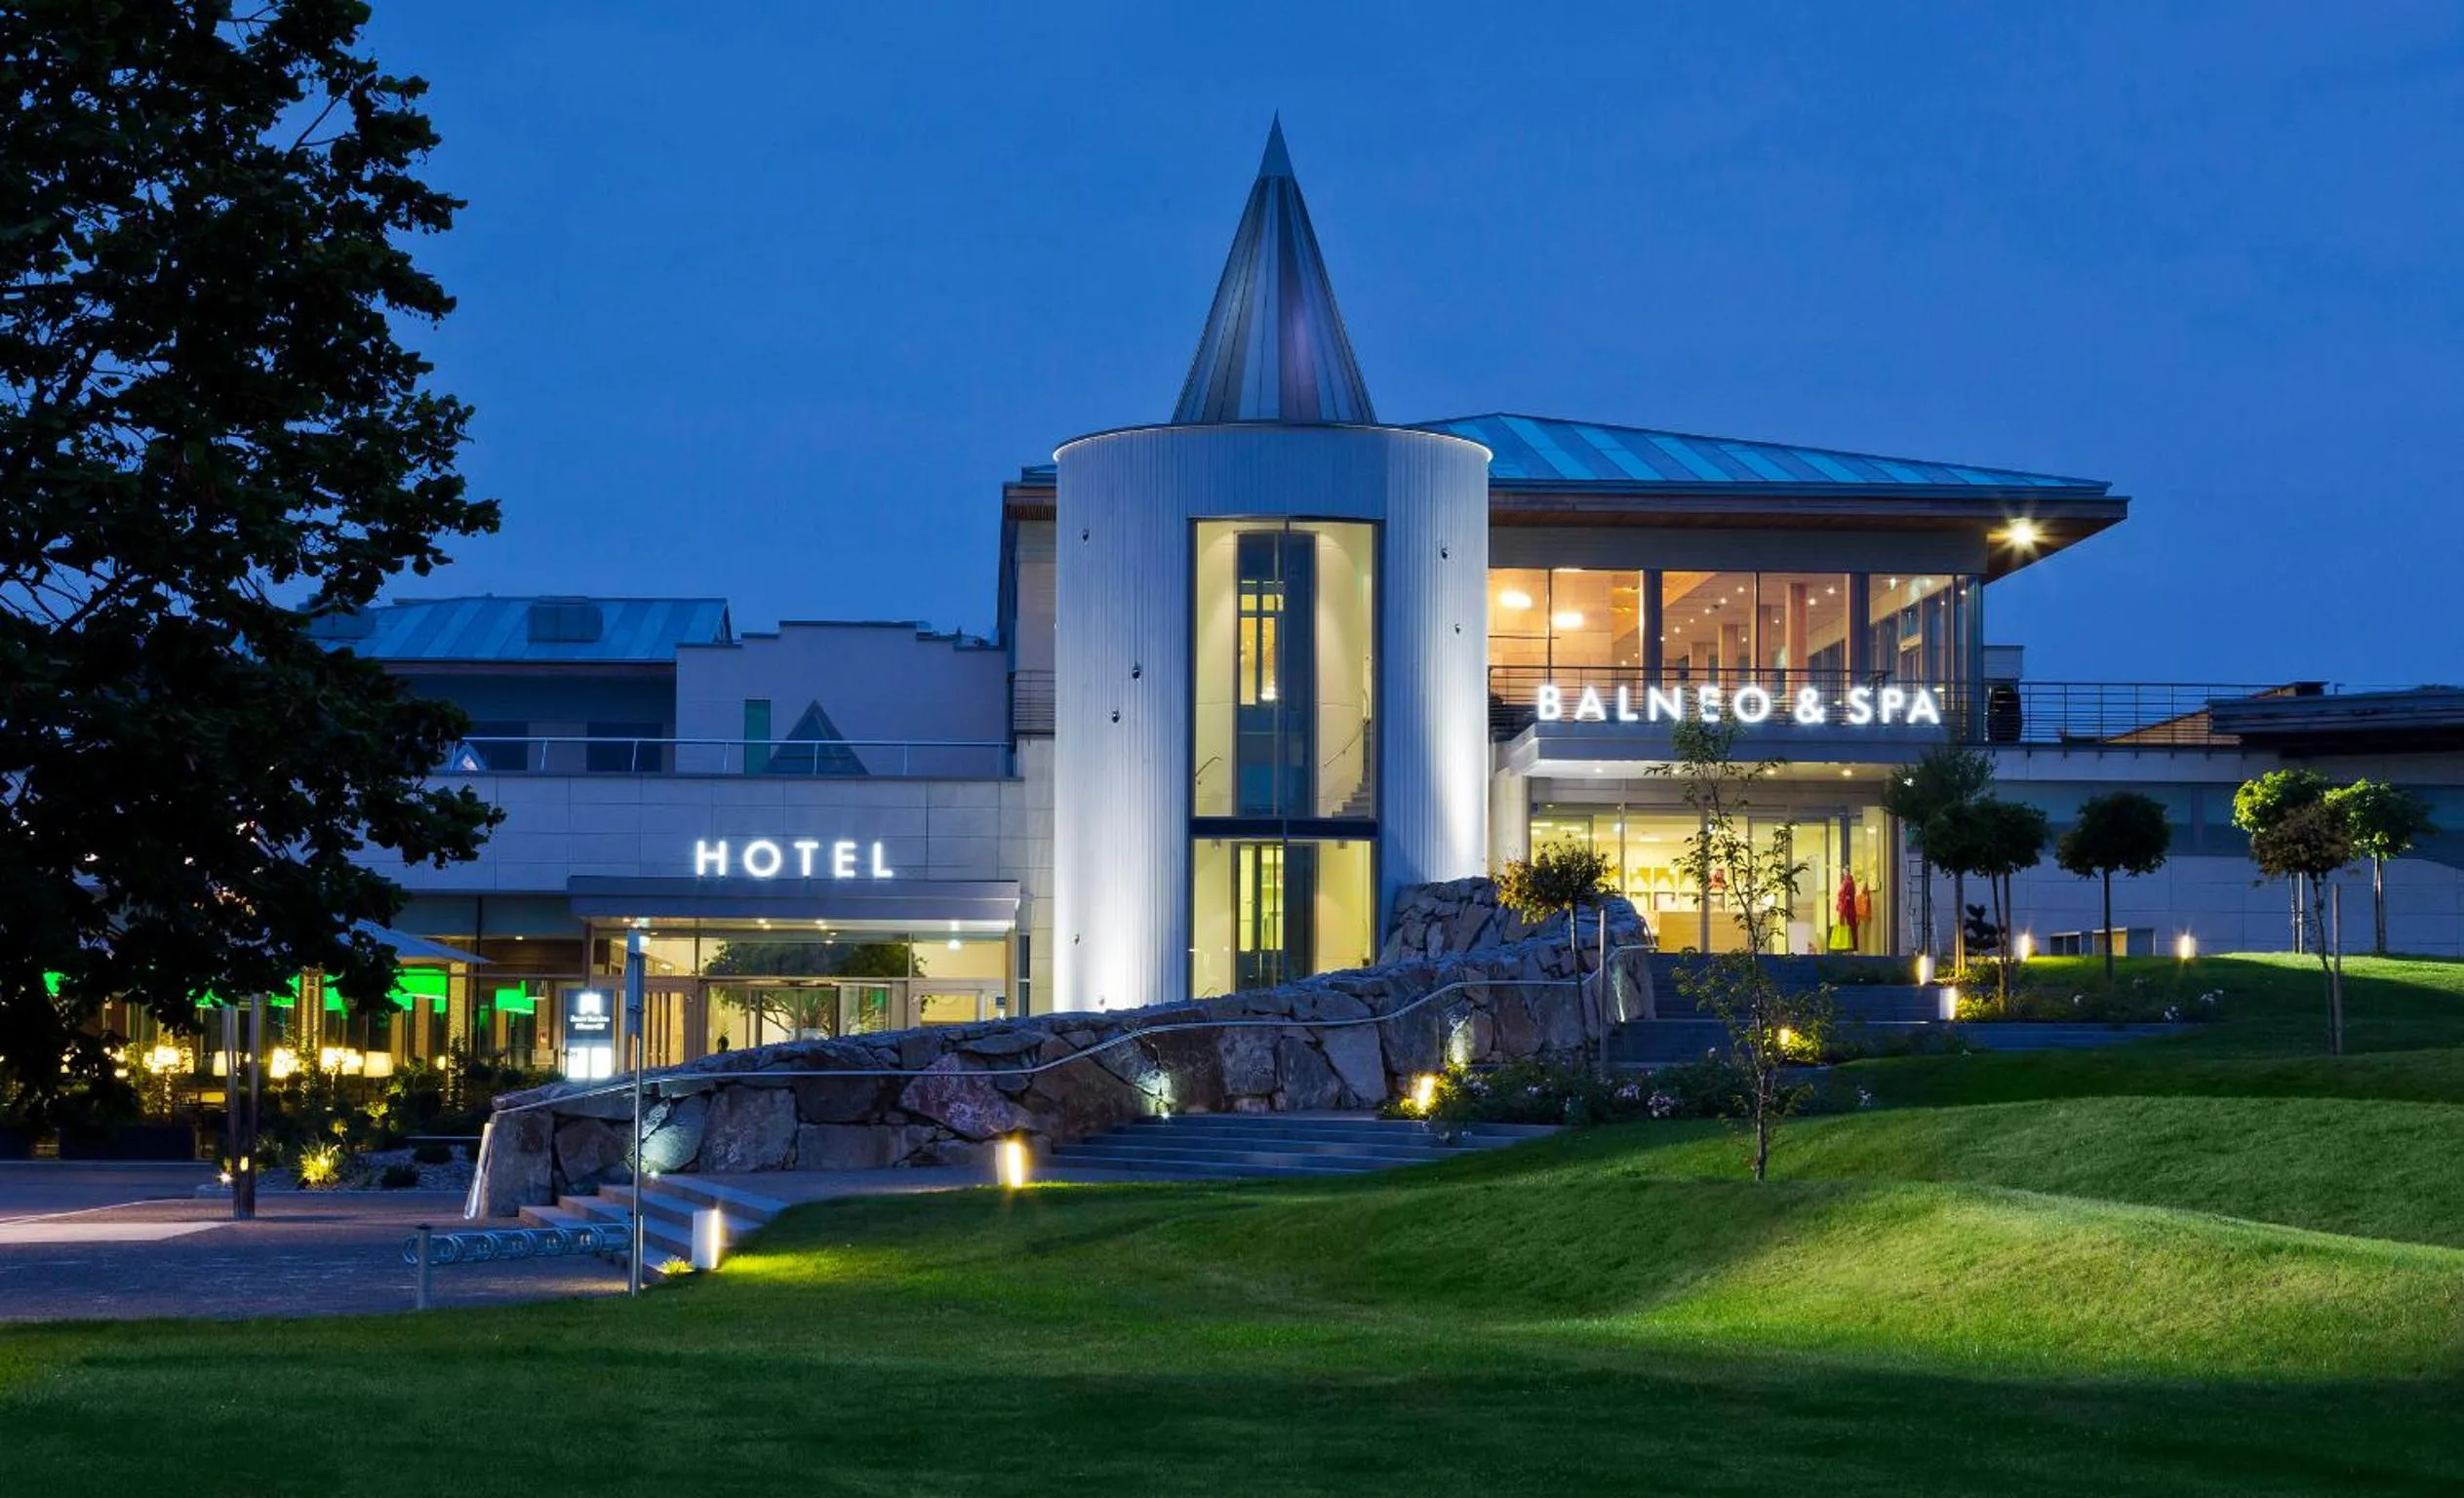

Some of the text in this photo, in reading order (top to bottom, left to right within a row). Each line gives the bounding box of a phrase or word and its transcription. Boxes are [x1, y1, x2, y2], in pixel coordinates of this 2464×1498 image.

[1536, 684, 1940, 724] BALNEO & SPA
[695, 839, 893, 878] HOTEL
